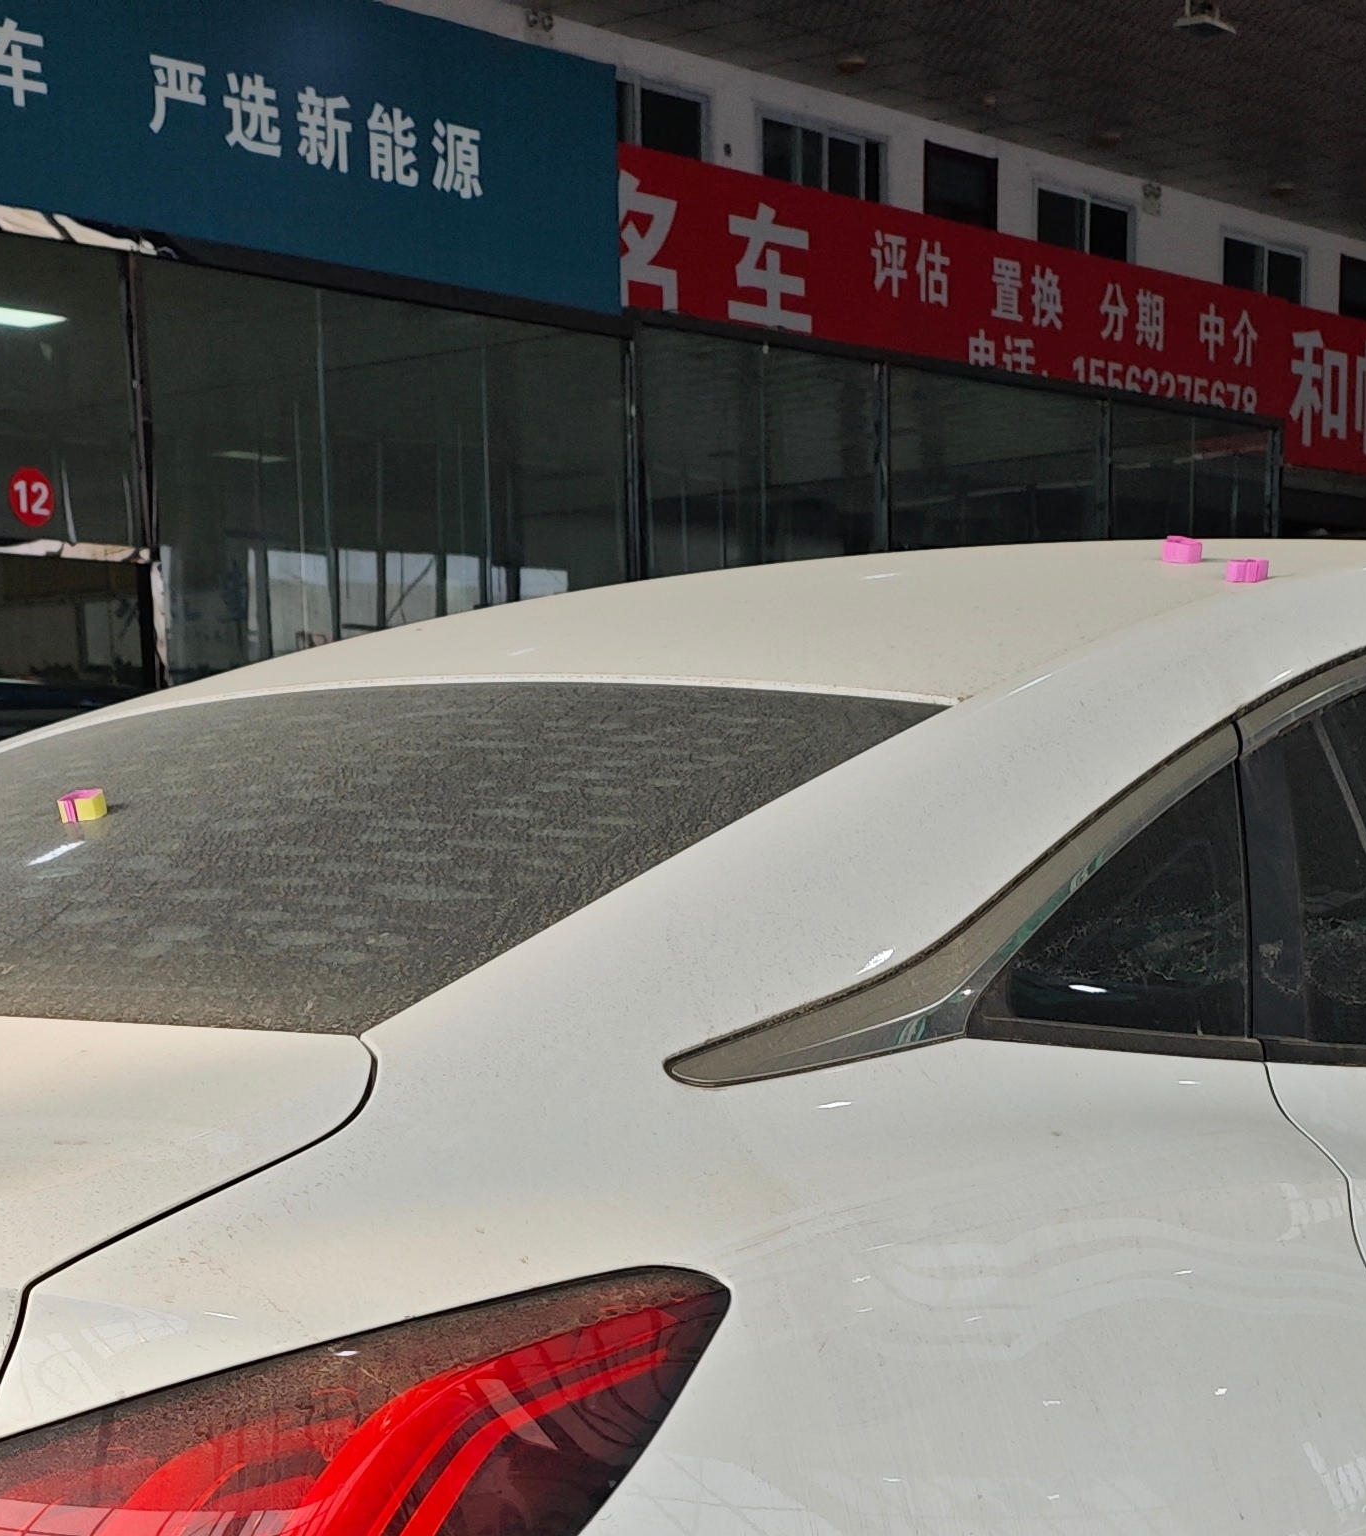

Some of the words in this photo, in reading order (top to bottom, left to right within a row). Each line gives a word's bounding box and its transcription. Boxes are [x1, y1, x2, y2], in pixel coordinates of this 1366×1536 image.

[150, 54, 483, 200] 严选新能源
[871, 230, 950, 308] 评估
[992, 258, 1064, 330] 置换
[1099, 282, 1165, 353] 分期
[1199, 302, 1259, 369] 中介
[13, 481, 50, 517] 12
